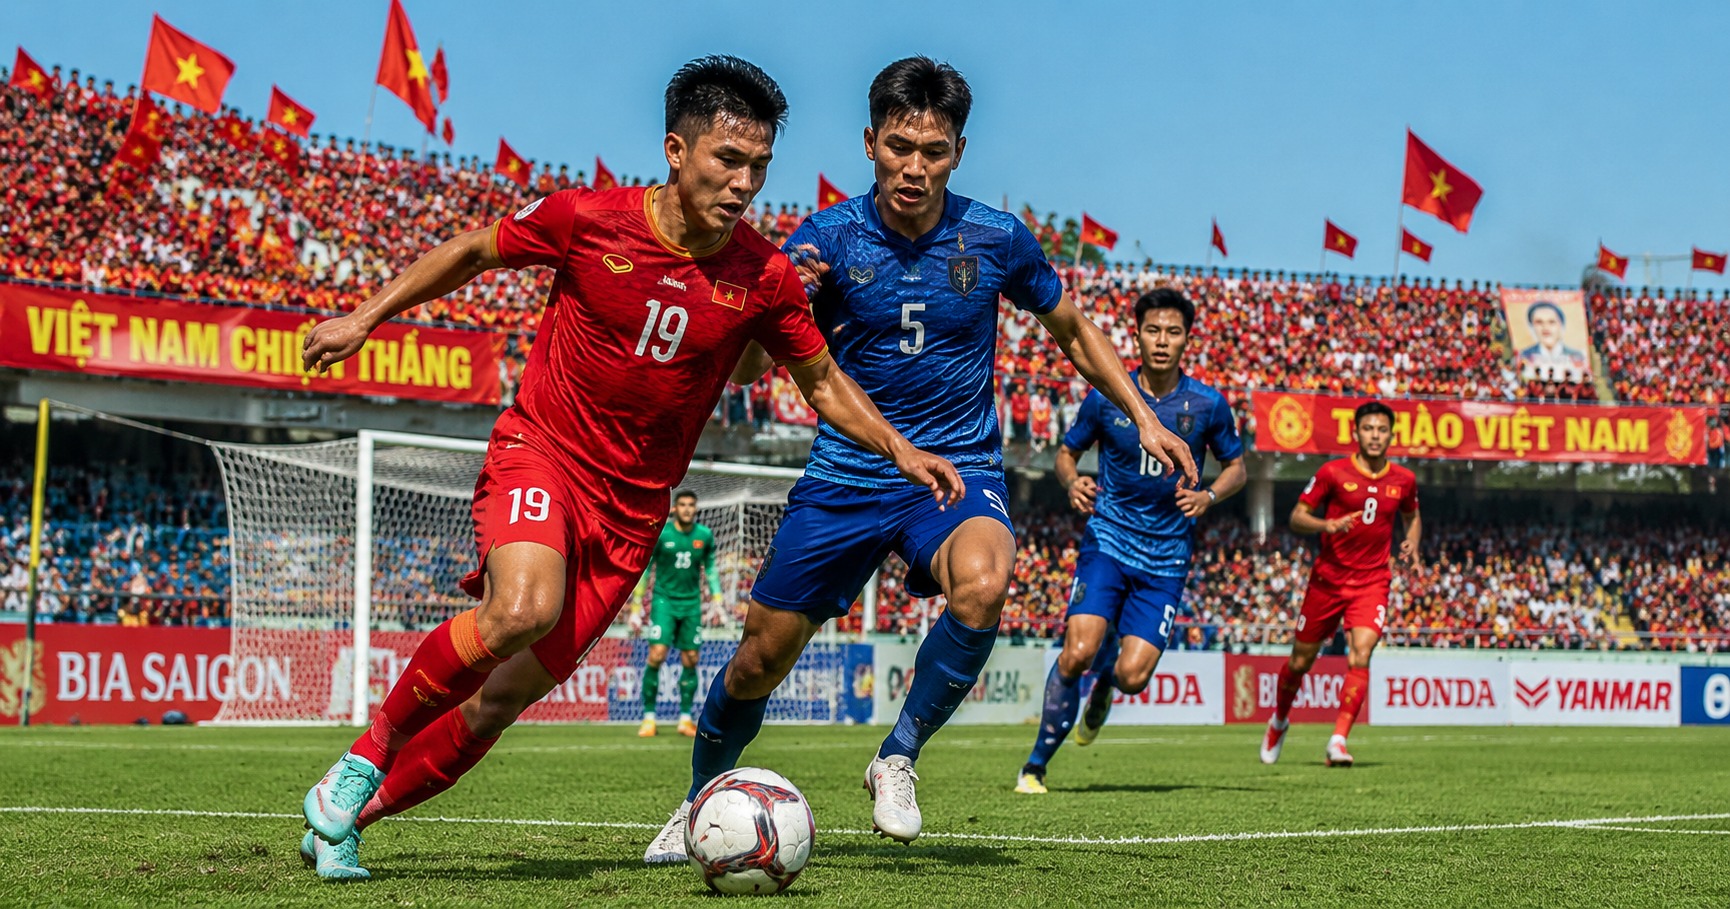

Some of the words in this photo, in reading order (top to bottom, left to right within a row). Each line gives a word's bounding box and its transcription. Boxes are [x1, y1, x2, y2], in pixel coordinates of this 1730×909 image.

[26, 300, 118, 367] VIỆT
[129, 315, 219, 368] NAM
[230, 317, 346, 385] CHI
[634, 298, 689, 363] 19
[899, 303, 926, 355] 5
[1473, 406, 1555, 458] VIỆT
[1565, 417, 1649, 453] NAM
[508, 486, 552, 525] 19
[1362, 497, 1378, 525] 8
[56, 651, 136, 701] BIA
[140, 651, 291, 702] SAIGON
[1258, 673, 1278, 708] BI
[1291, 672, 1345, 709] AIGO
[1386, 677, 1496, 708] HONDA
[1556, 679, 1673, 711] YANMAR
